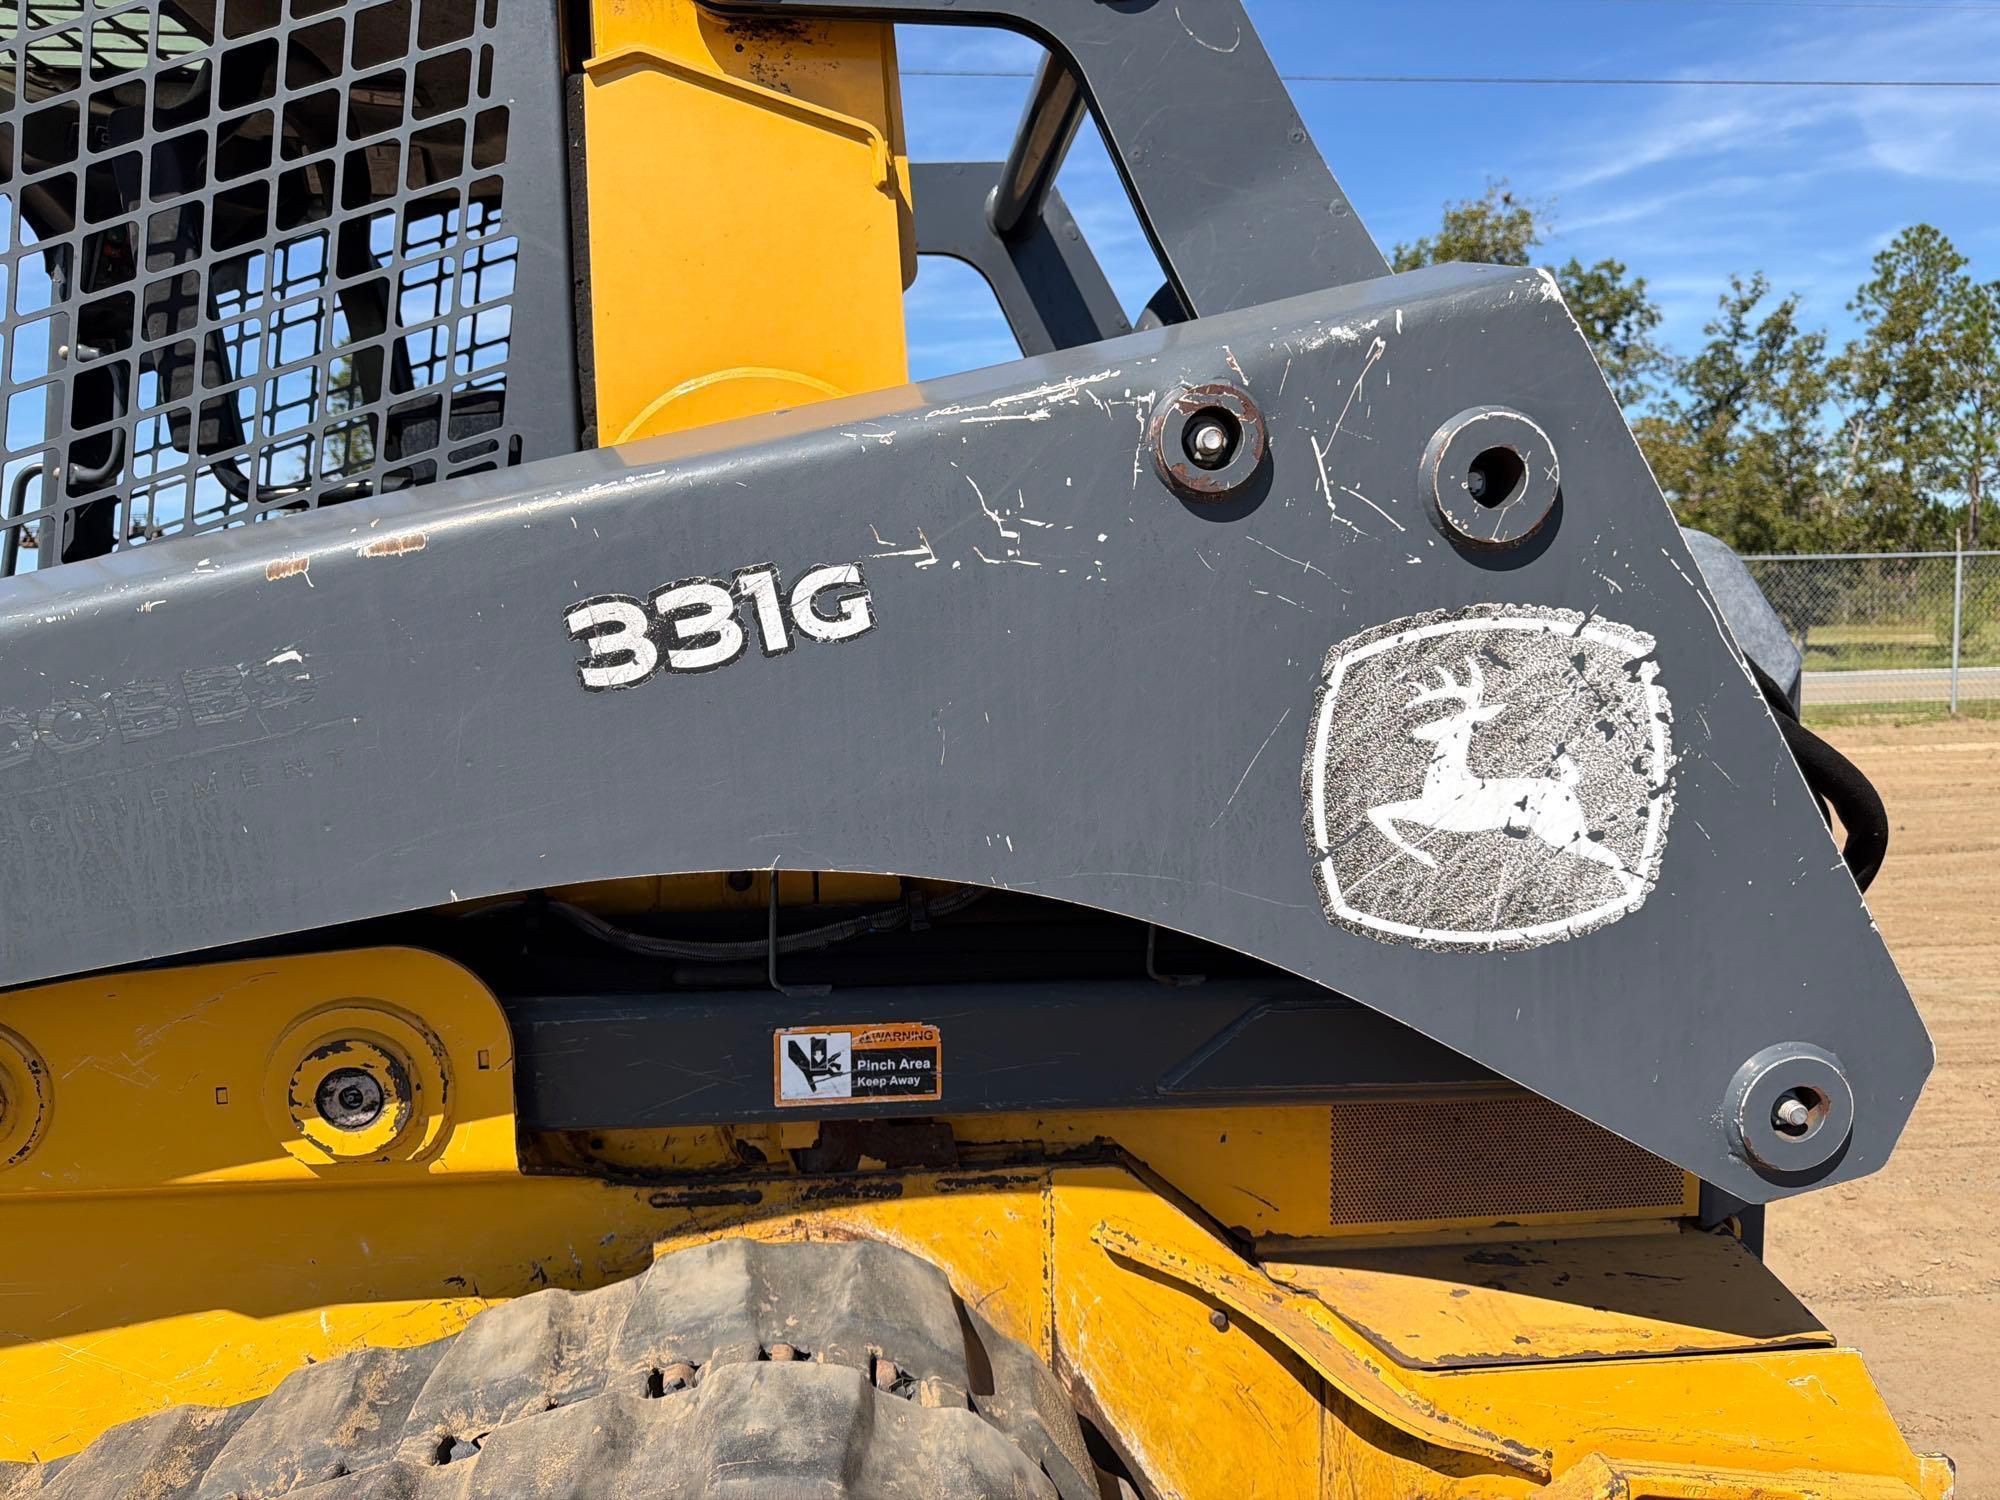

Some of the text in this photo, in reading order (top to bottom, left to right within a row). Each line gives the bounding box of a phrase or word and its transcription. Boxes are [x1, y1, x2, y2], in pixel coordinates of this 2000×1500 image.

[564, 563, 875, 689] 331G
[872, 1030, 934, 1043] WARNING
[857, 1058, 931, 1072] Pinch Area
[857, 1075, 921, 1089] Keep Away
